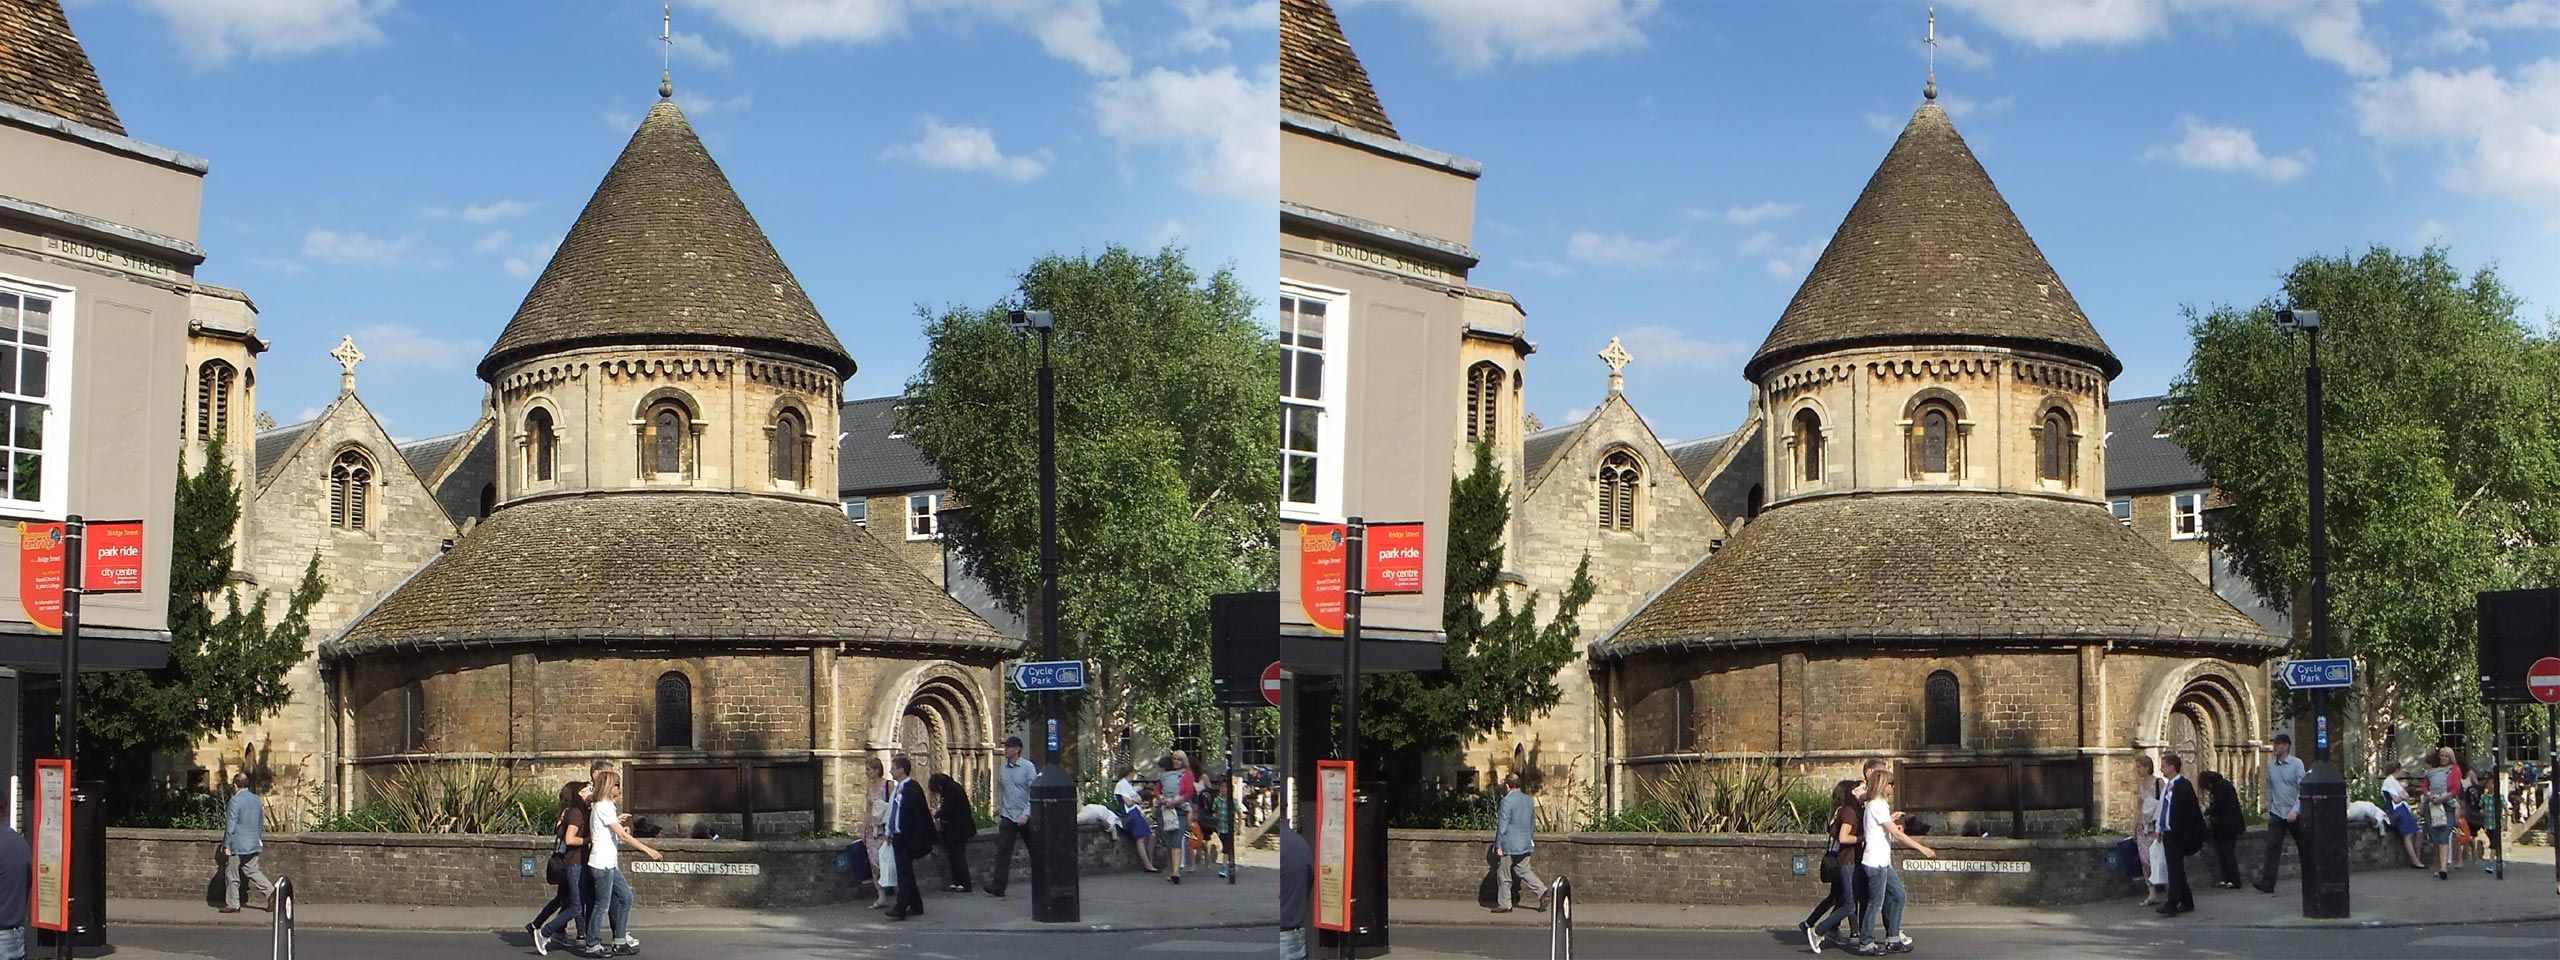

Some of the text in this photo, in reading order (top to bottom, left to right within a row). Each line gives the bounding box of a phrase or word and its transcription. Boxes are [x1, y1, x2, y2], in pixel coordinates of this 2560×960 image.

[61, 239, 171, 276] BRIDGE STREET
[1336, 243, 1445, 279] BRIDGE STREET
[98, 545, 138, 560] park ride
[1379, 546, 1419, 562] park ride
[101, 568, 114, 578] city
[115, 568, 137, 576] centre
[1382, 569, 1418, 580] city centre
[1028, 667, 1053, 676] Cycle
[2297, 665, 2322, 674] Cycle
[2300, 674, 2320, 683] Park
[634, 862, 755, 875] ROUND CHURCH STREET
[1905, 860, 2027, 872] ROUND CHURCH STREET
